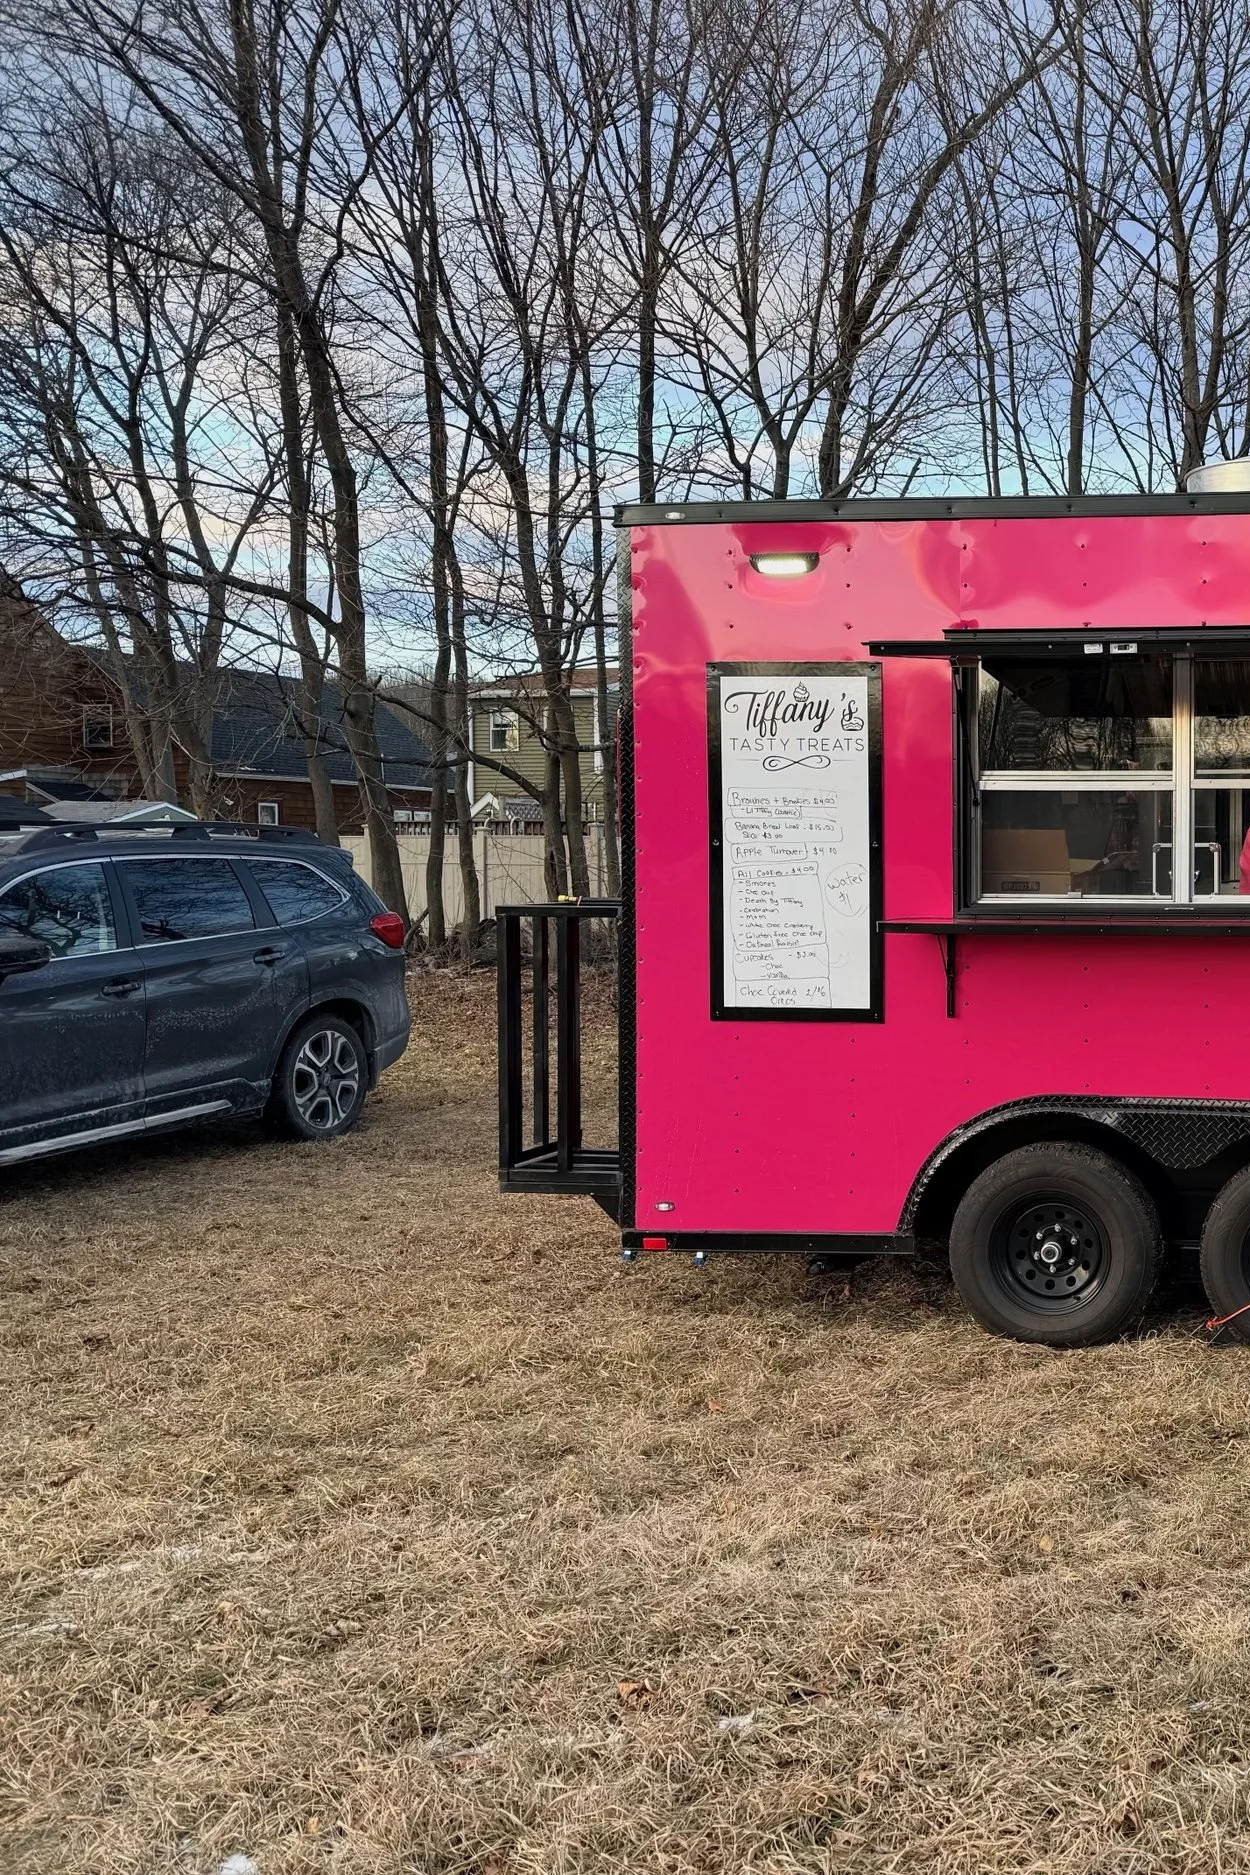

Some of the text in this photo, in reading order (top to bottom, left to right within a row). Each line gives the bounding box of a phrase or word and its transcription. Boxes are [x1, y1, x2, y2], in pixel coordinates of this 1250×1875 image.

[724, 689, 859, 737] Tiffany's
[729, 738, 865, 752] TASTY TREATS
[734, 821, 761, 832] Banana
[762, 822, 781, 830] Bread
[735, 846, 763, 859] Apple
[737, 870, 752, 879] All
